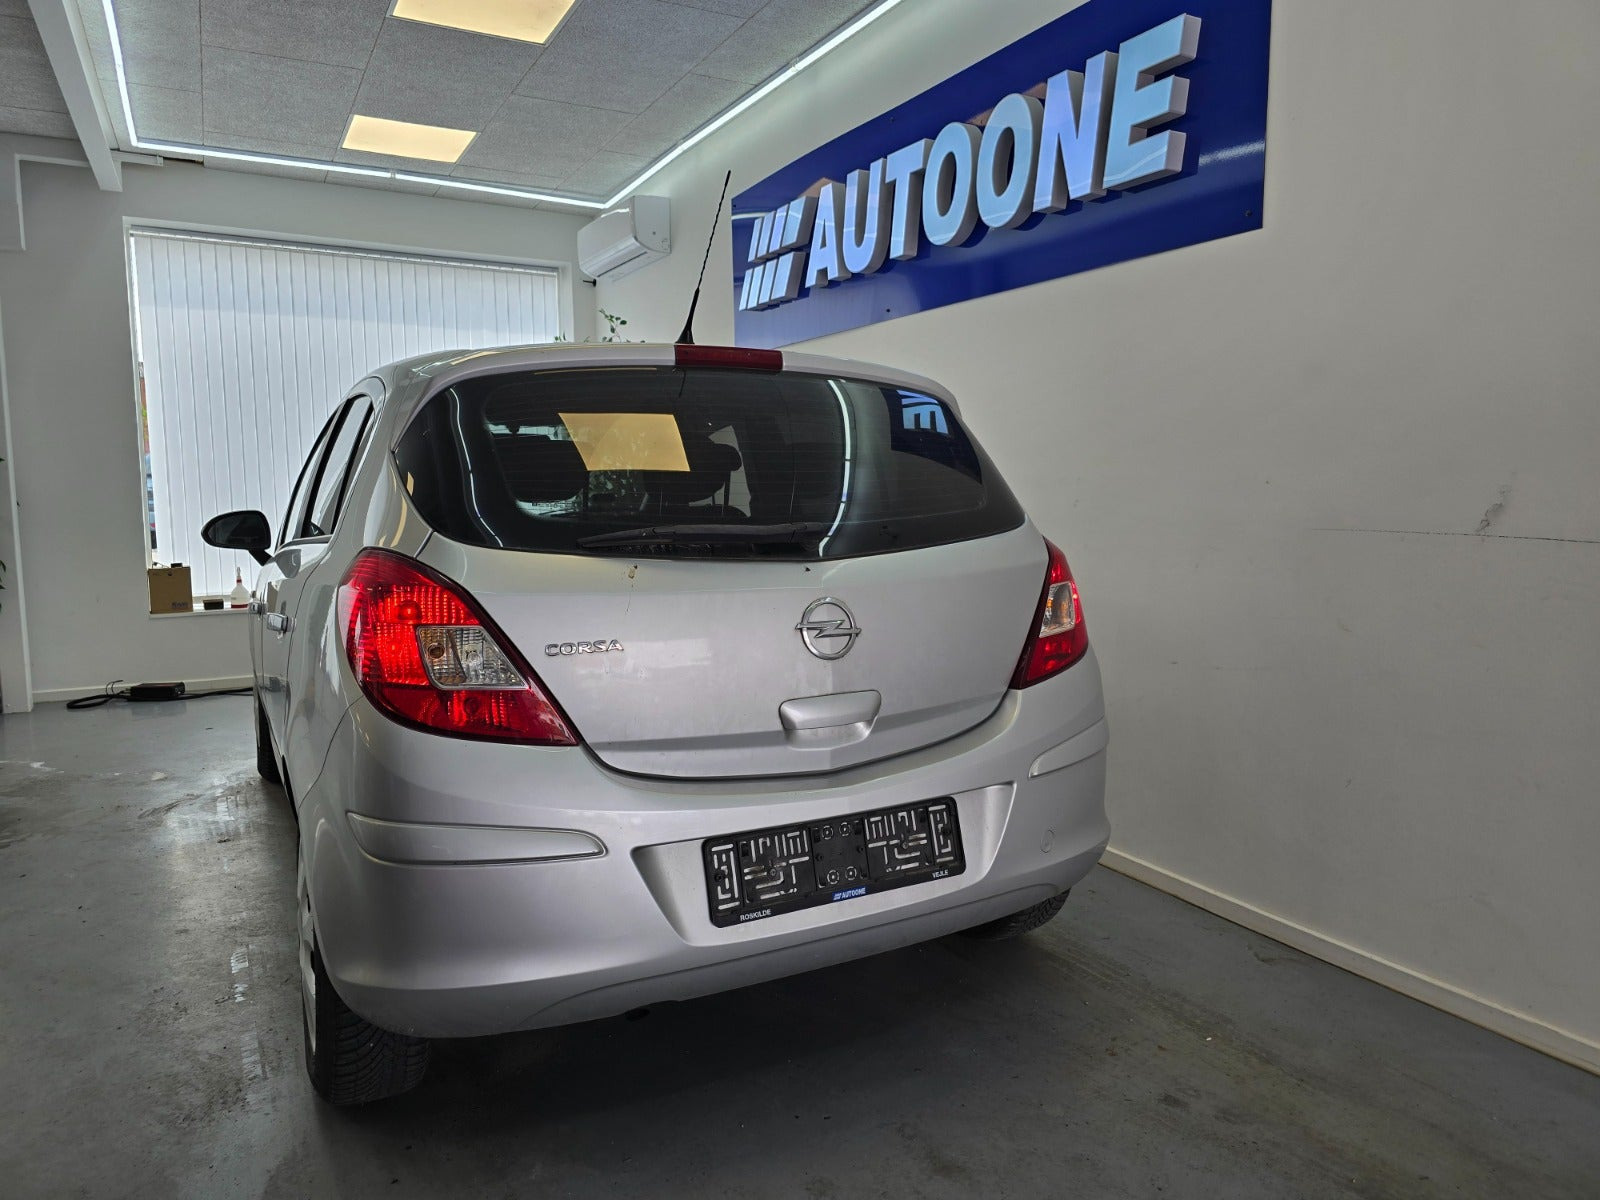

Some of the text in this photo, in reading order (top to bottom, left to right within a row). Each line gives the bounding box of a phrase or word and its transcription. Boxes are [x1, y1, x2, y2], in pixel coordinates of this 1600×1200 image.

[805, 13, 1201, 288] AUTOONE
[545, 639, 624, 656] CORSA
[932, 869, 949, 878] VEJLE
[841, 887, 866, 899] AUTOONE
[740, 909, 772, 921] ROSKILDE
